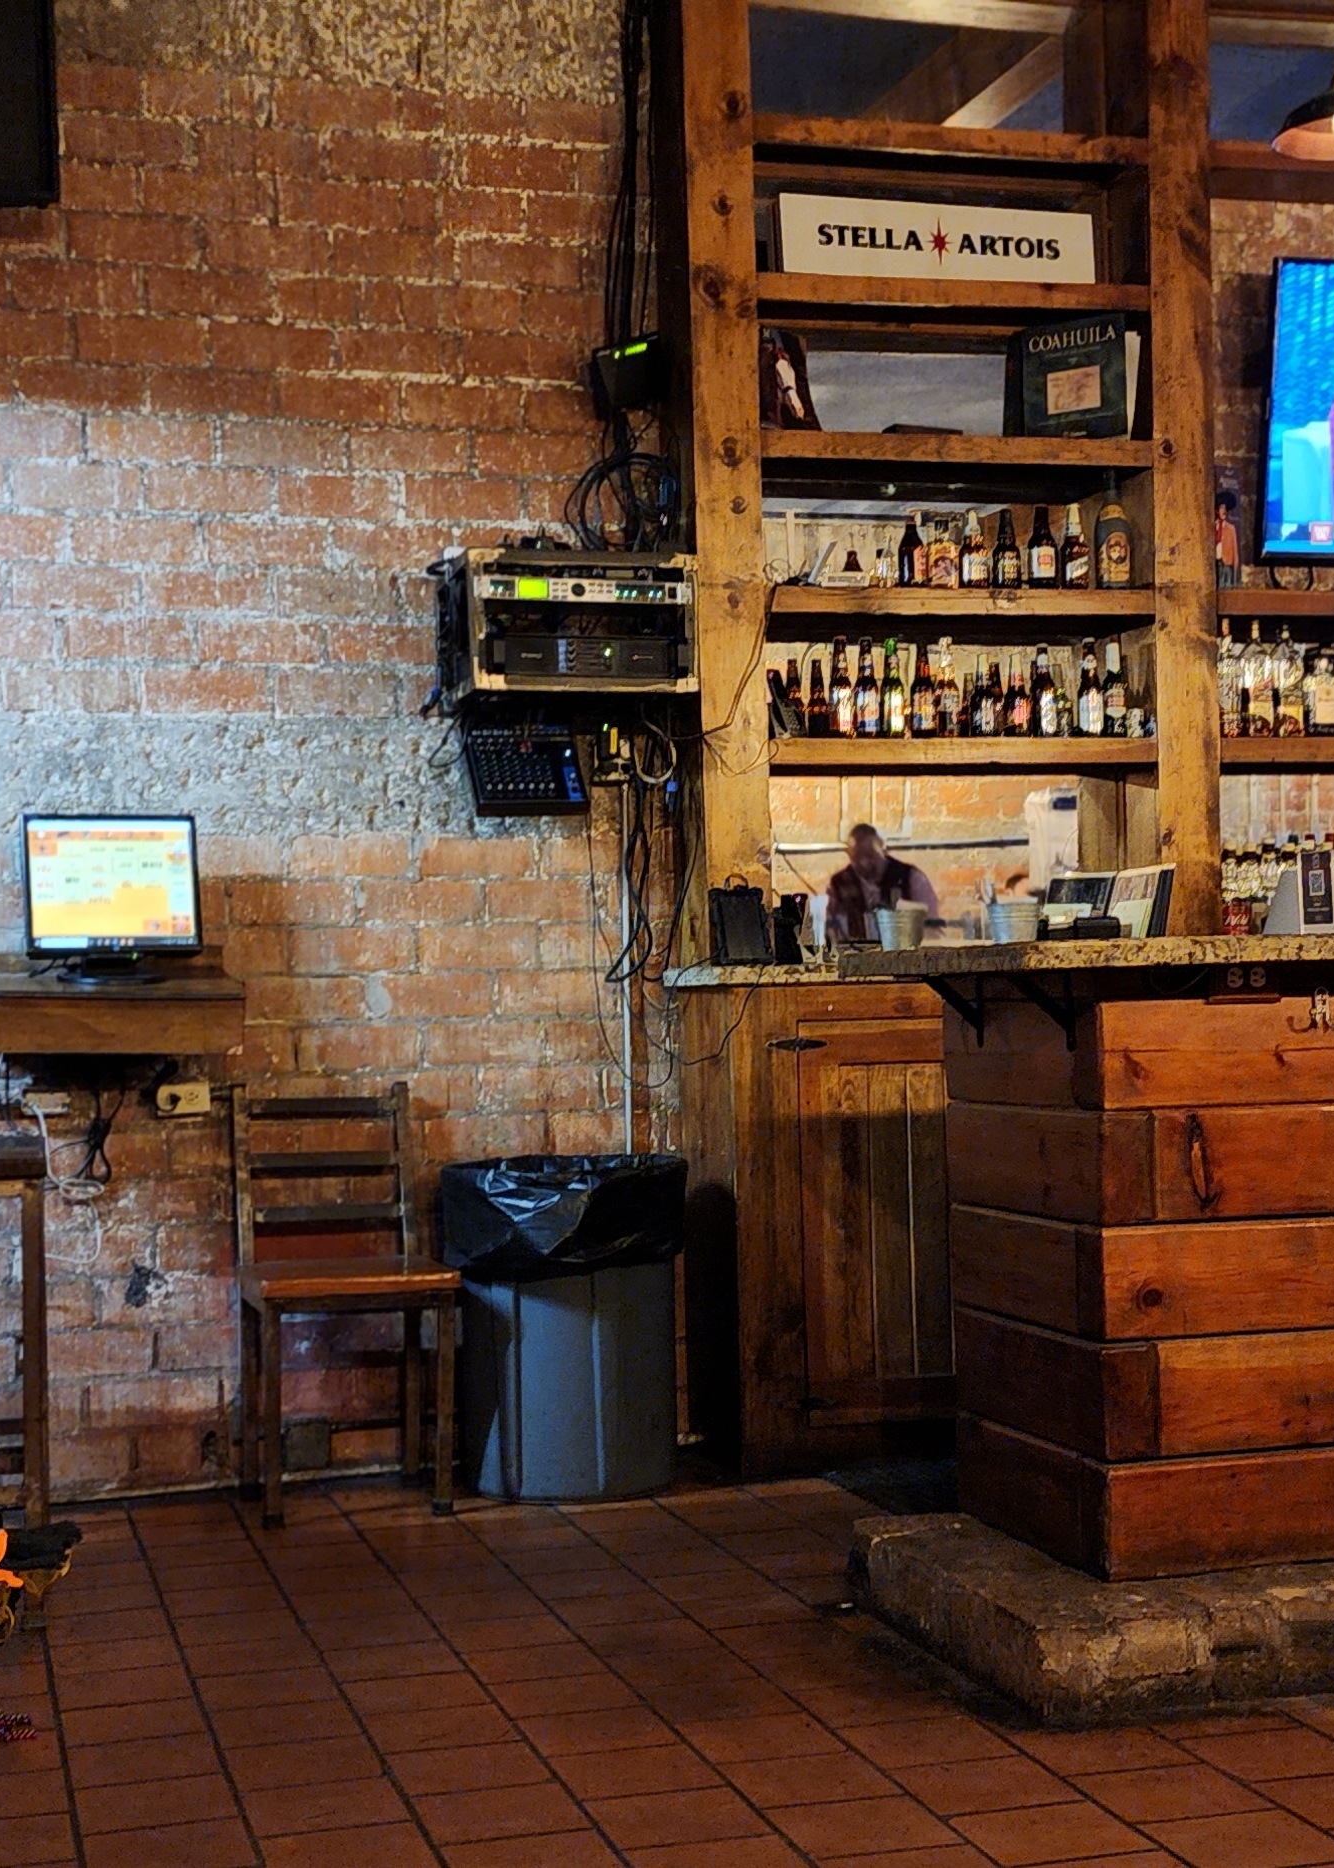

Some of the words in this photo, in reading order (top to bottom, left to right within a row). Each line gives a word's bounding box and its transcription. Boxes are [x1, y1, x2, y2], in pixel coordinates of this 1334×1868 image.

[817, 223, 924, 251] STELLA
[958, 233, 1061, 260] ARTOIS
[1028, 323, 1116, 353] COAHUILA
